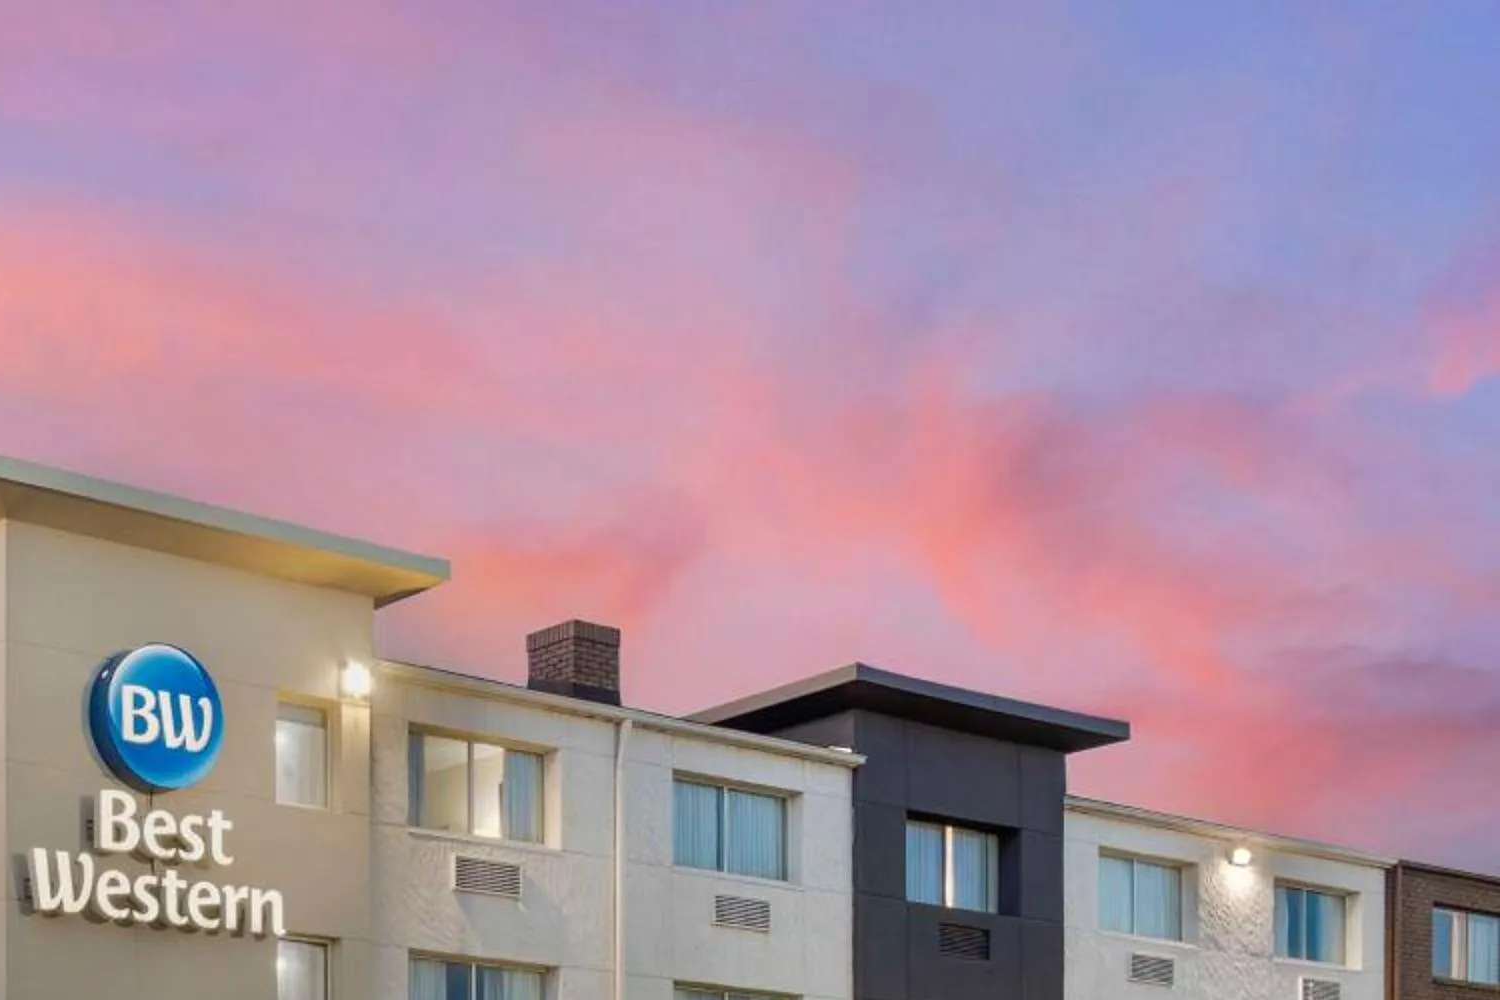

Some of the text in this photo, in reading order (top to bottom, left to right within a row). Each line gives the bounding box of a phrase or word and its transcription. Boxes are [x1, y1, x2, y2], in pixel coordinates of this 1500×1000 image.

[121, 685, 213, 752] BW
[100, 789, 234, 865] Best
[33, 847, 286, 937] Western
